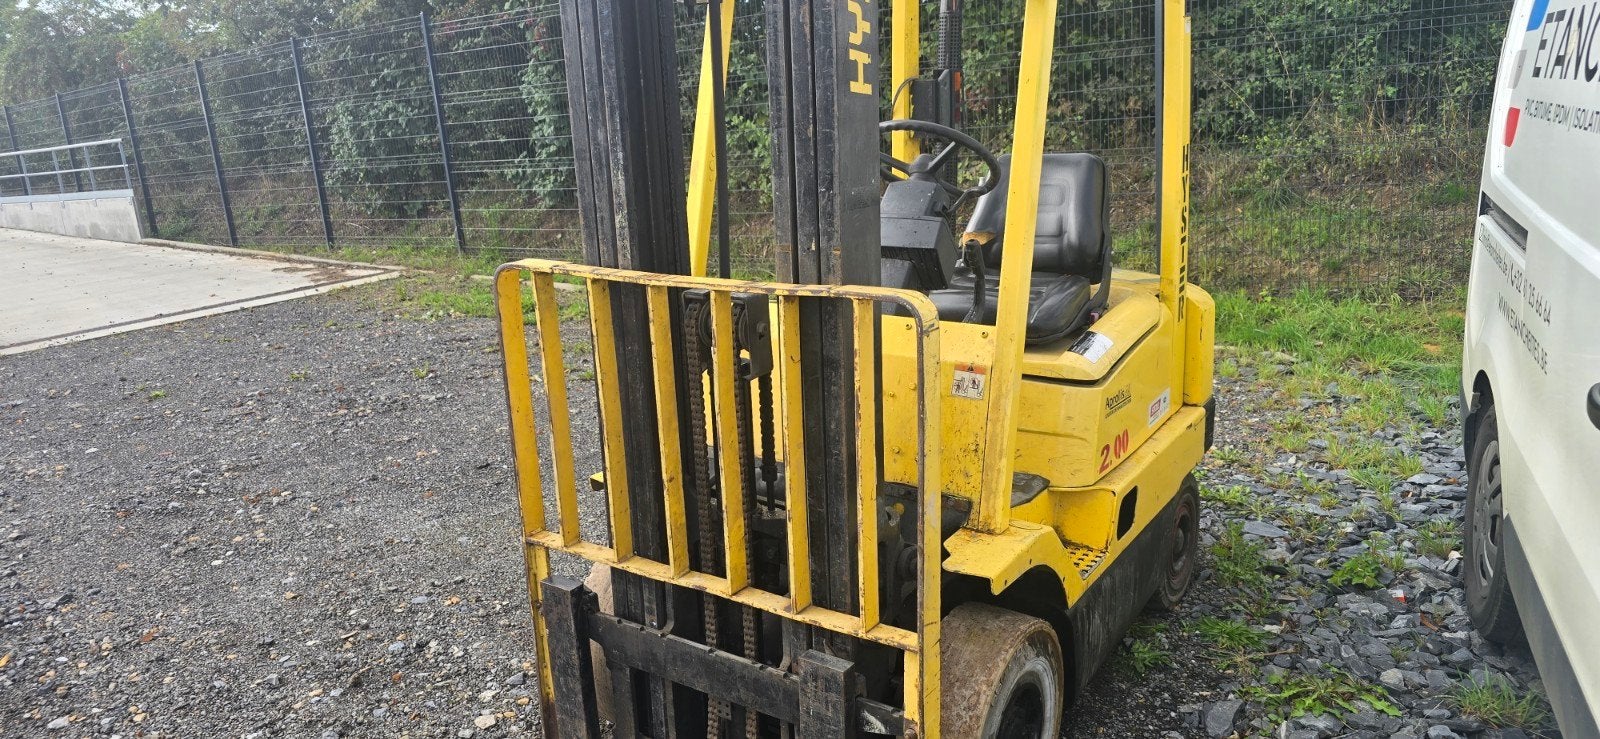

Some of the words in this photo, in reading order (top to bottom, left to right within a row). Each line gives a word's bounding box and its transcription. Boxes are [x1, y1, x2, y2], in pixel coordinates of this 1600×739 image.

[847, 0, 872, 95] HY
[1532, 2, 1600, 82] ETANC
[1178, 143, 1190, 323] HYSTER
